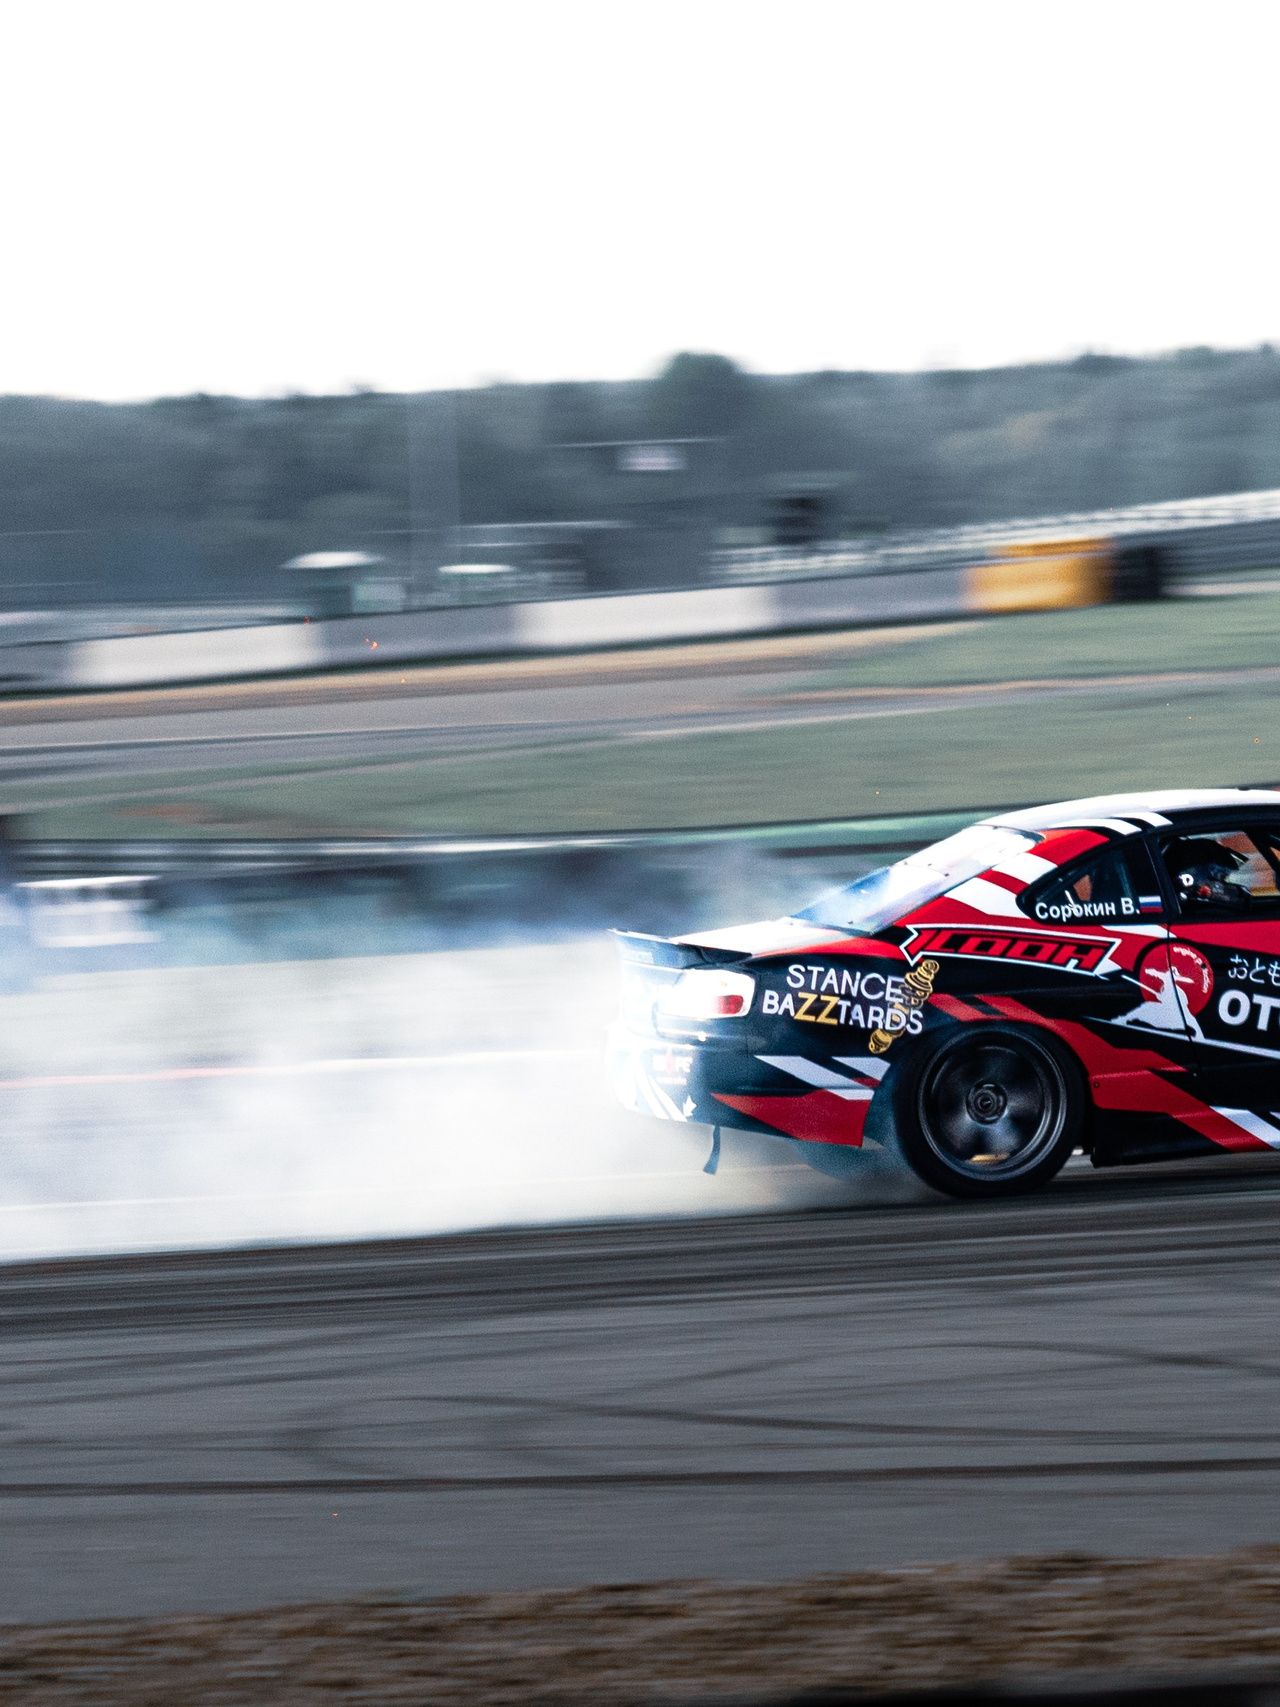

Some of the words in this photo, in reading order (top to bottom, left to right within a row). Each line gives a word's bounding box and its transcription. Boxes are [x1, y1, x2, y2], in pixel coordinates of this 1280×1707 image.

[1035, 901, 1116, 922] Сорокин
[786, 964, 905, 1003] STANCE
[762, 990, 923, 1035] BAZZTARDS
